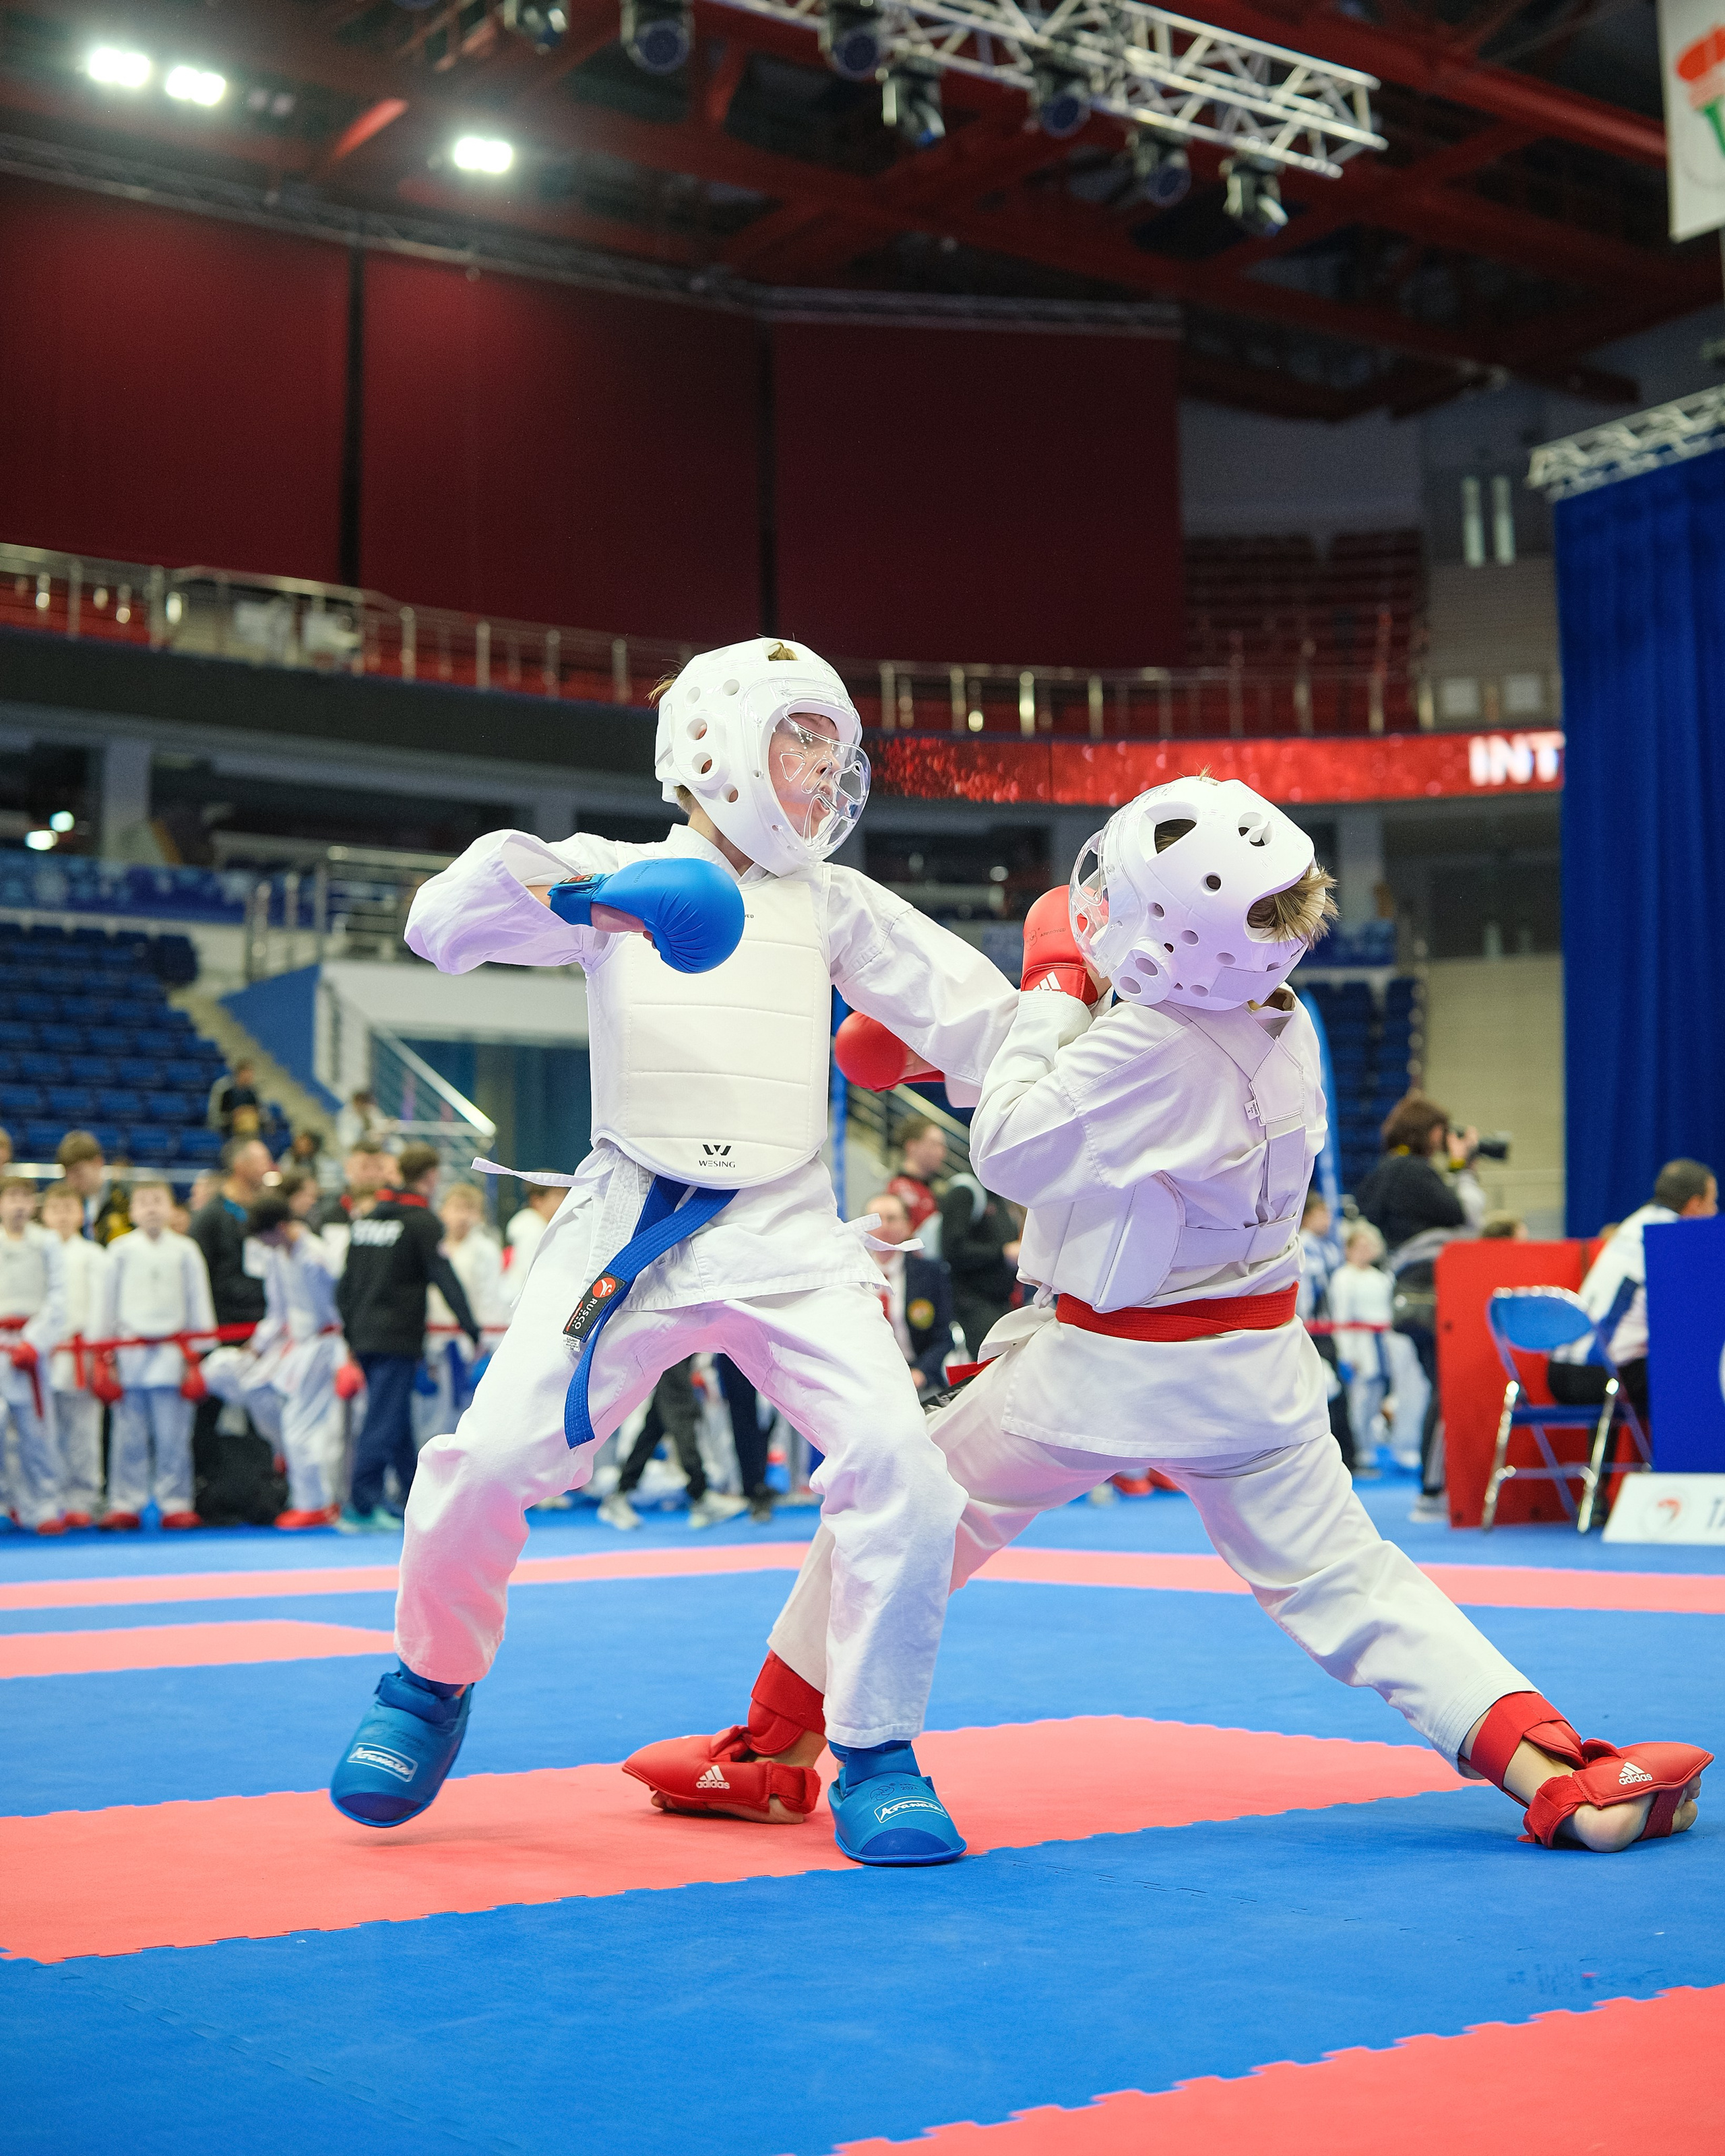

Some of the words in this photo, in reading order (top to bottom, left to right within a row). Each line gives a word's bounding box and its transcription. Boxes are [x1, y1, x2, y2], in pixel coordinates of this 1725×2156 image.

[1469, 731, 1565, 786] INT
[699, 1160, 735, 1168] WESING
[574, 1298, 598, 1330] RUSCO
[696, 1781, 730, 1789] adidas
[1619, 1773, 1653, 1785] adidas
